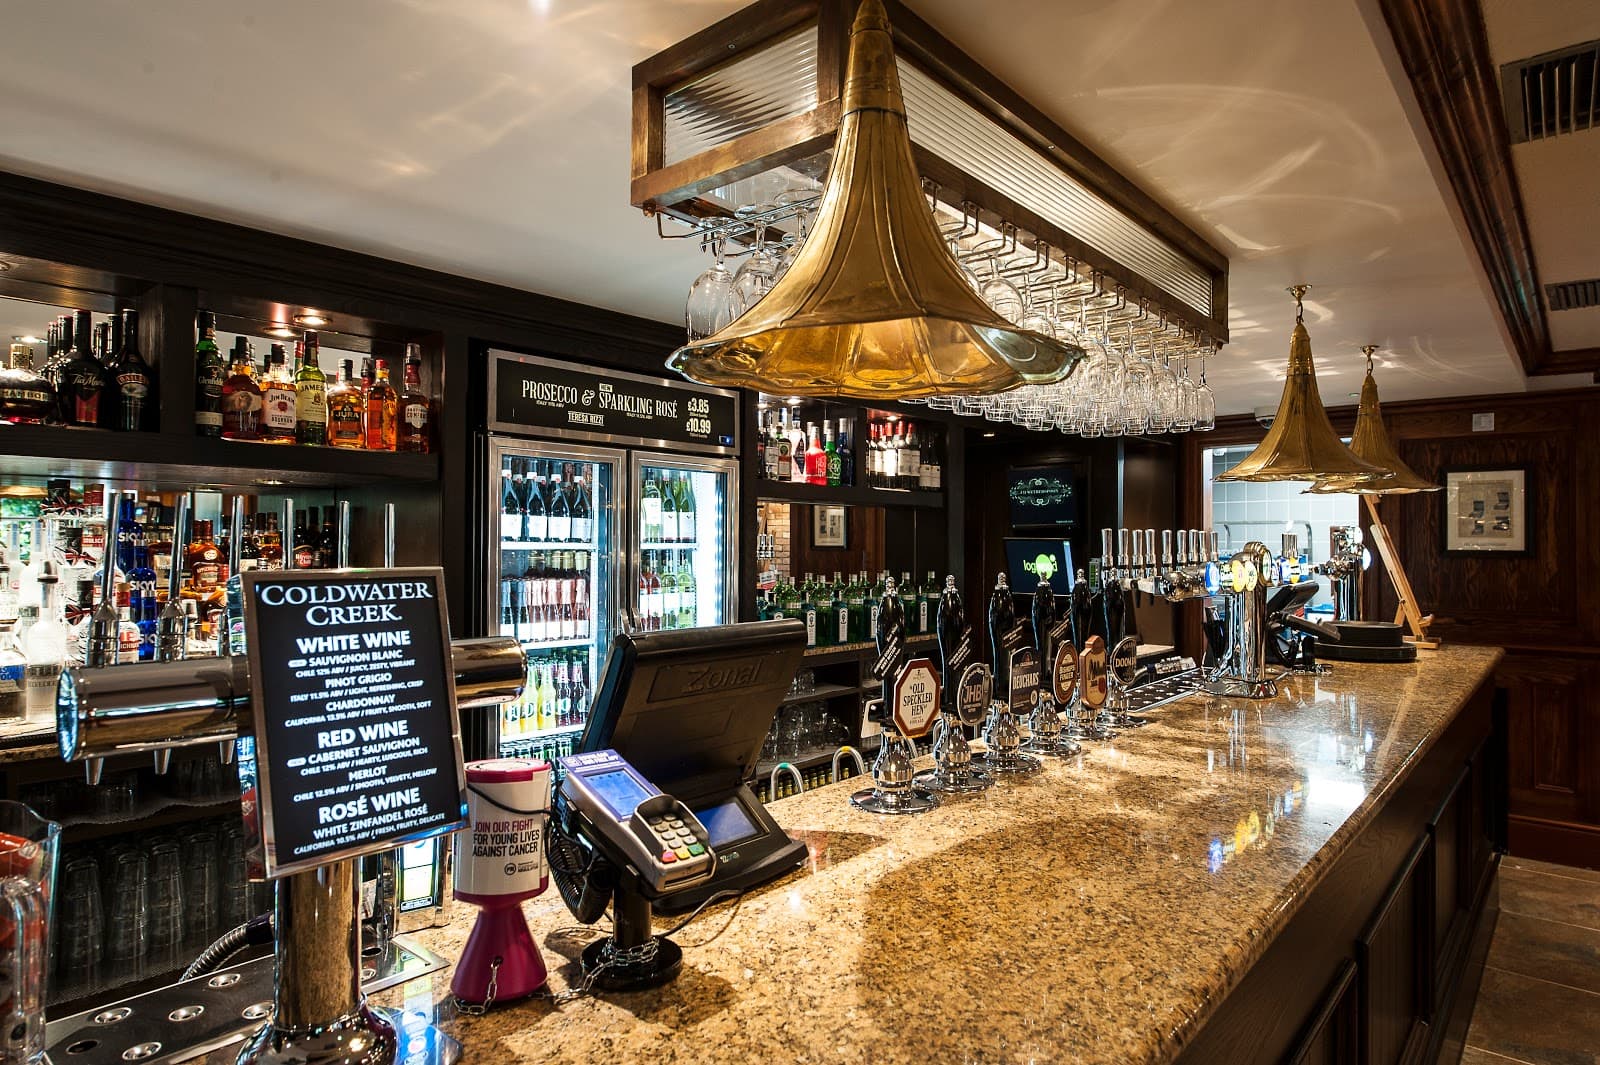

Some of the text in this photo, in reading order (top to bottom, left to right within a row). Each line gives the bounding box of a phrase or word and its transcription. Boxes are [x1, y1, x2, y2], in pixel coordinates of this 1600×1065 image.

[300, 383, 325, 392] JAMES
[522, 379, 678, 419] PROSECCO & SPARKLING ROSÉ
[687, 397, 710, 414] £3.85
[335, 411, 360, 419] JURA
[568, 412, 589, 423] TERESA
[686, 417, 711, 434] £10.99
[129, 580, 156, 591] SKYY
[261, 582, 433, 606] COLDWATER
[305, 603, 402, 626] CREEK
[295, 630, 412, 655] WHITE WINE
[309, 653, 371, 667] SAUVIGNON
[371, 650, 403, 661] BLANC
[295, 669, 316, 678] CHILE
[316, 667, 331, 676] 12%
[331, 666, 345, 674] ABV
[389, 659, 416, 668] VIBRANT
[685, 657, 765, 692] Zonal
[325, 672, 393, 689] PINOT GRIGIO
[290, 694, 309, 703] ITALY
[330, 690, 344, 699] ABV
[903, 692, 933, 707] SPECKLED
[963, 684, 983, 704] JHB
[325, 694, 396, 712] CHARDONNAY
[285, 715, 326, 728] CALIFORNIA
[346, 710, 361, 719] ABV
[416, 700, 433, 709] SOFT
[317, 719, 409, 749] RED WINE
[307, 746, 361, 765] CABERNET
[362, 736, 421, 756] SAUVIGNON
[300, 766, 321, 777] CHILE
[321, 763, 337, 773] 12%
[336, 761, 351, 771] ABV
[348, 765, 388, 782] MERLOT
[293, 792, 314, 803] CHILE
[314, 787, 336, 798] 12.5%
[335, 785, 350, 795] ABV
[412, 767, 438, 779] MELLOW
[318, 786, 421, 824] ROSÉ WINE
[313, 803, 429, 840] WHITE ZINFANDEL ROSÉ
[473, 818, 533, 833] JOIN OUR FIGHT
[293, 839, 336, 856] CALIFORNIA
[335, 834, 356, 846] 10.5%
[356, 831, 371, 841] ABV
[375, 825, 397, 836] FRESH,
[396, 819, 419, 832] FRUITY,
[418, 812, 446, 826] DELICATE
[473, 828, 540, 845] FOR YOUNG LIVES
[472, 841, 538, 858] AGAINST CANCER
